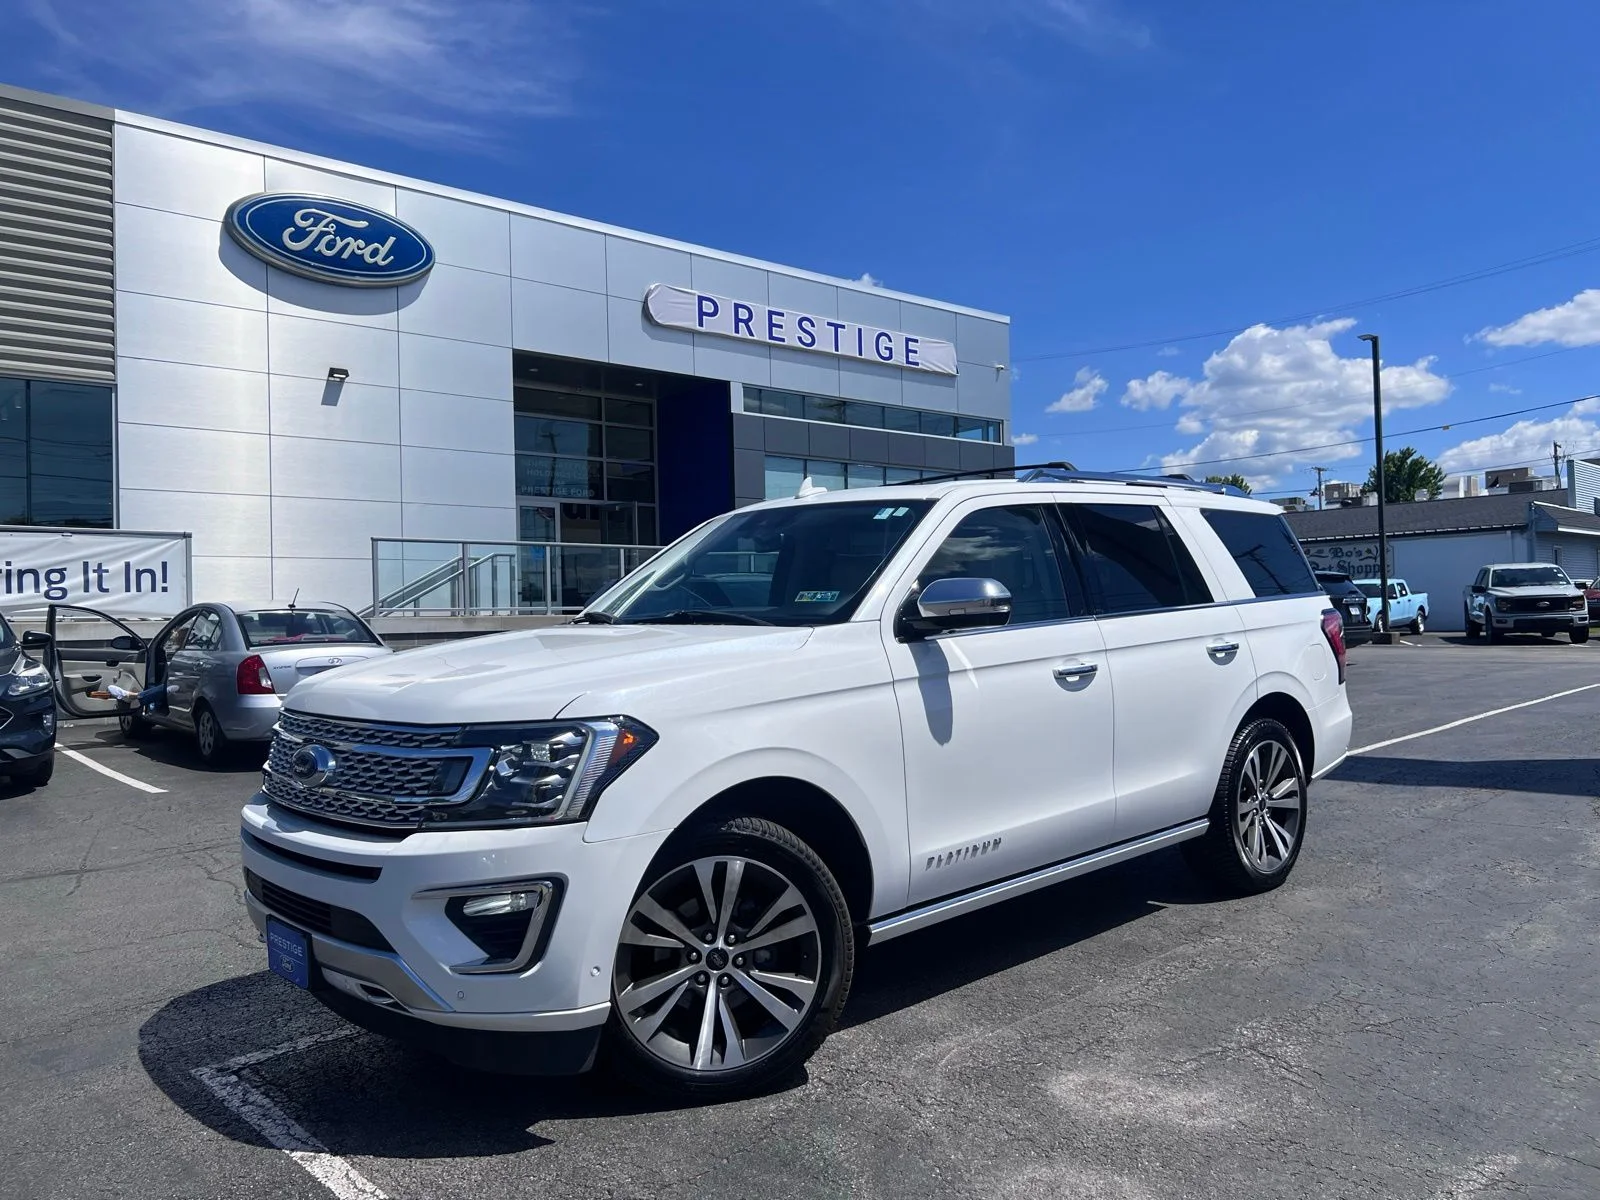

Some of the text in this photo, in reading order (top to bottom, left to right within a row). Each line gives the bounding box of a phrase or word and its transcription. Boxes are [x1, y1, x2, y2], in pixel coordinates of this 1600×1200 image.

[282, 208, 397, 266] Ford
[697, 295, 920, 367] PRESTIGE
[0, 561, 168, 600] ing It In!
[270, 932, 303, 957] PRESTIGE
